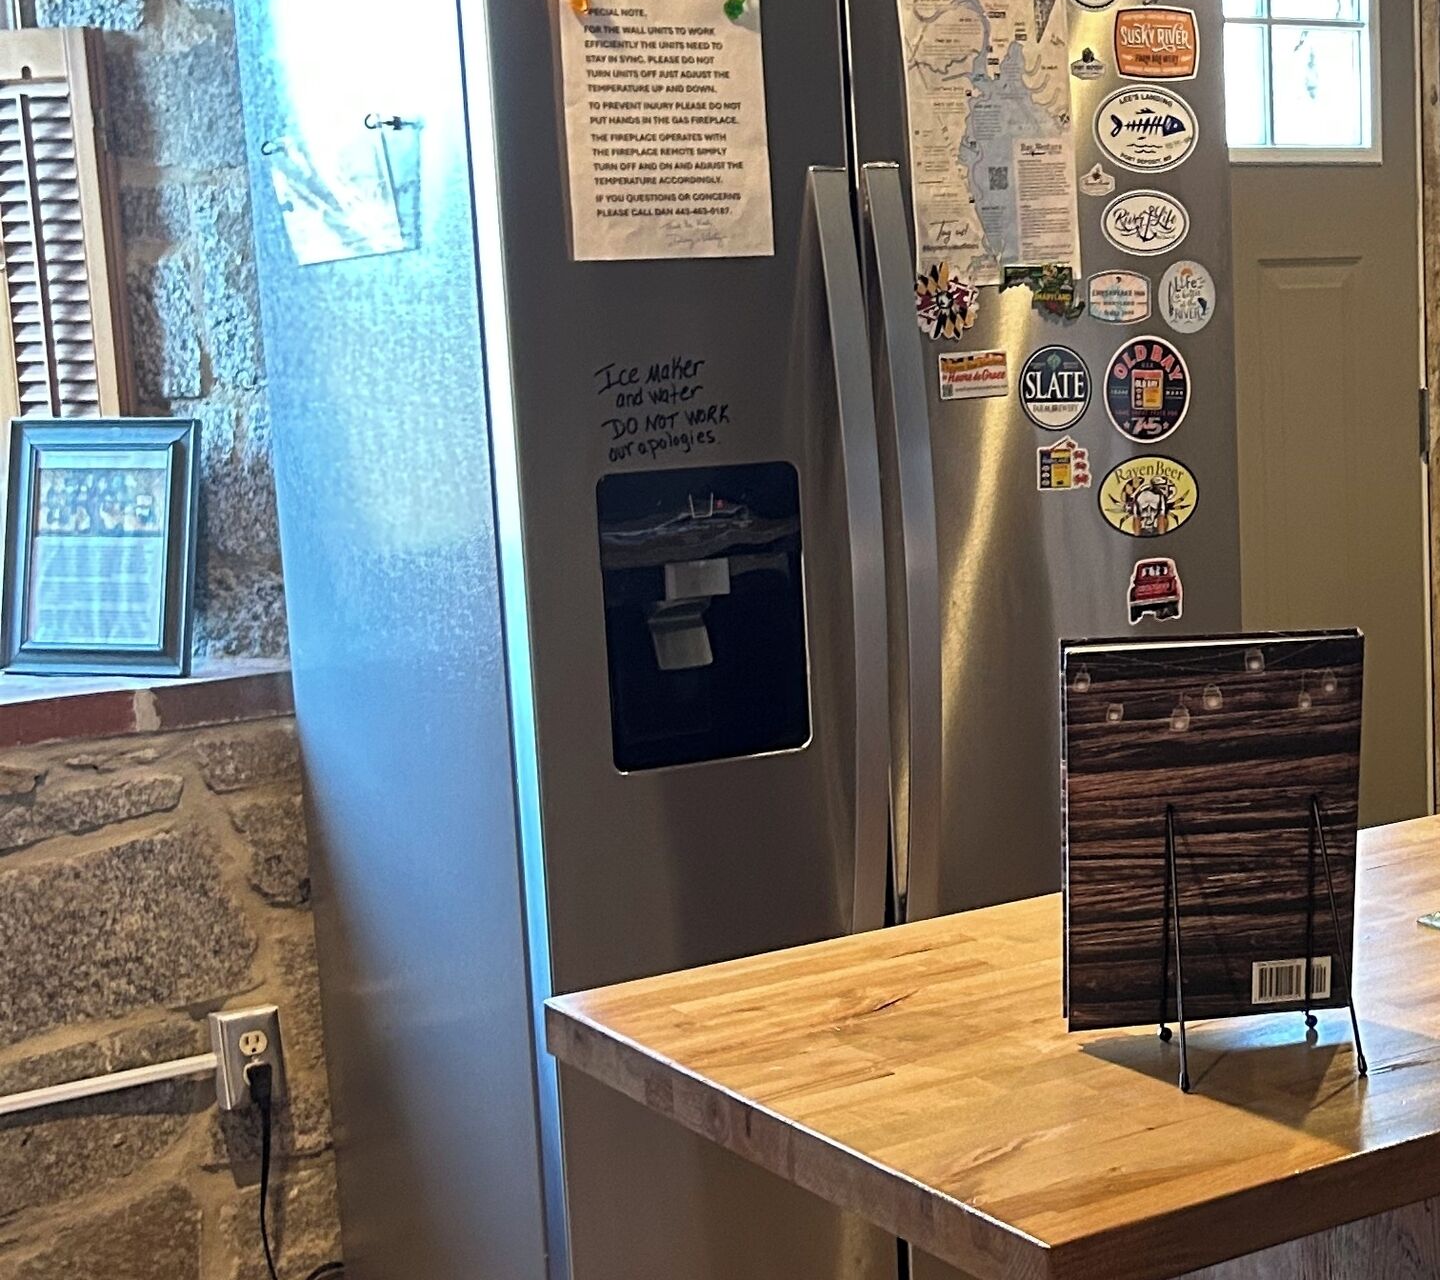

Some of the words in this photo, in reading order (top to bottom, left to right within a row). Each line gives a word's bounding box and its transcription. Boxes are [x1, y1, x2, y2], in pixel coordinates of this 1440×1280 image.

[588, 8, 620, 18] PECIAL
[584, 25, 602, 35] FOR
[602, 25, 620, 35] THE
[622, 25, 646, 35] WALL
[646, 25, 674, 35] UNITS
[676, 26, 688, 36] TO
[688, 26, 716, 36] WORK
[1120, 23, 1155, 48] SUSKY
[1152, 23, 1191, 52] RIVER
[584, 40, 640, 50] EFFICIENTLY
[640, 40, 658, 50] THE
[658, 40, 684, 50] UNITS
[686, 41, 710, 51] NEED
[710, 41, 724, 51] TO
[586, 55, 608, 64] STAY
[608, 55, 618, 64] IN
[648, 55, 680, 65] PLEASE
[680, 55, 696, 65] DO
[696, 55, 716, 65] NOT
[586, 69, 612, 79] TURN
[612, 69, 640, 79] UNITS
[640, 69, 658, 79] OFF
[658, 70, 678, 79] JUST
[680, 70, 712, 79] ADJUST
[714, 70, 730, 79] THE
[586, 84, 650, 93] TEMPERATURE
[650, 84, 664, 93] UP
[664, 84, 684, 93] AND
[588, 101, 600, 110] TO
[602, 101, 642, 110] PREVENT
[642, 101, 674, 110] INJURY
[674, 101, 706, 110] PLEASE
[708, 101, 722, 110] DO
[722, 101, 742, 110] NOT
[1141, 94, 1173, 108] LANDING
[590, 116, 608, 125] PUT
[608, 116, 640, 125] HANDS
[642, 116, 652, 125] IN
[652, 116, 672, 125] THE
[672, 116, 690, 125] GAS
[590, 133, 608, 142] THE
[610, 133, 658, 142] FIREPLACE
[658, 133, 702, 142] OPERATES
[704, 133, 726, 142] WITH
[592, 147, 610, 156] THE
[610, 147, 658, 156] FIREPLACE
[660, 147, 696, 156] REMOTE
[696, 147, 728, 156] SIMPLY
[592, 162, 618, 171] TURN
[620, 162, 636, 171] OFF
[638, 162, 658, 171] AND
[658, 162, 674, 171] ON
[674, 161, 694, 170] AND
[694, 161, 726, 170] ADJUST
[726, 161, 744, 170] THE
[594, 176, 658, 185] TEMPERATURE
[596, 194, 604, 202] IF
[604, 194, 624, 202] YOU
[626, 194, 676, 202] QUESTIONS
[678, 193, 692, 201] OR
[692, 193, 742, 201] CONCERNS
[596, 208, 628, 217] PLEASE
[630, 208, 654, 216] CALL
[654, 207, 674, 216] DAN
[1114, 345, 1147, 379] OLD
[1150, 344, 1183, 380] BAY
[594, 363, 640, 395] Ice
[1025, 371, 1085, 399] SLATE
[616, 387, 643, 408] and
[648, 384, 704, 404] water
[601, 417, 638, 440] DO
[646, 412, 679, 431] NOT
[685, 404, 730, 426] WORK
[609, 442, 634, 462] our
